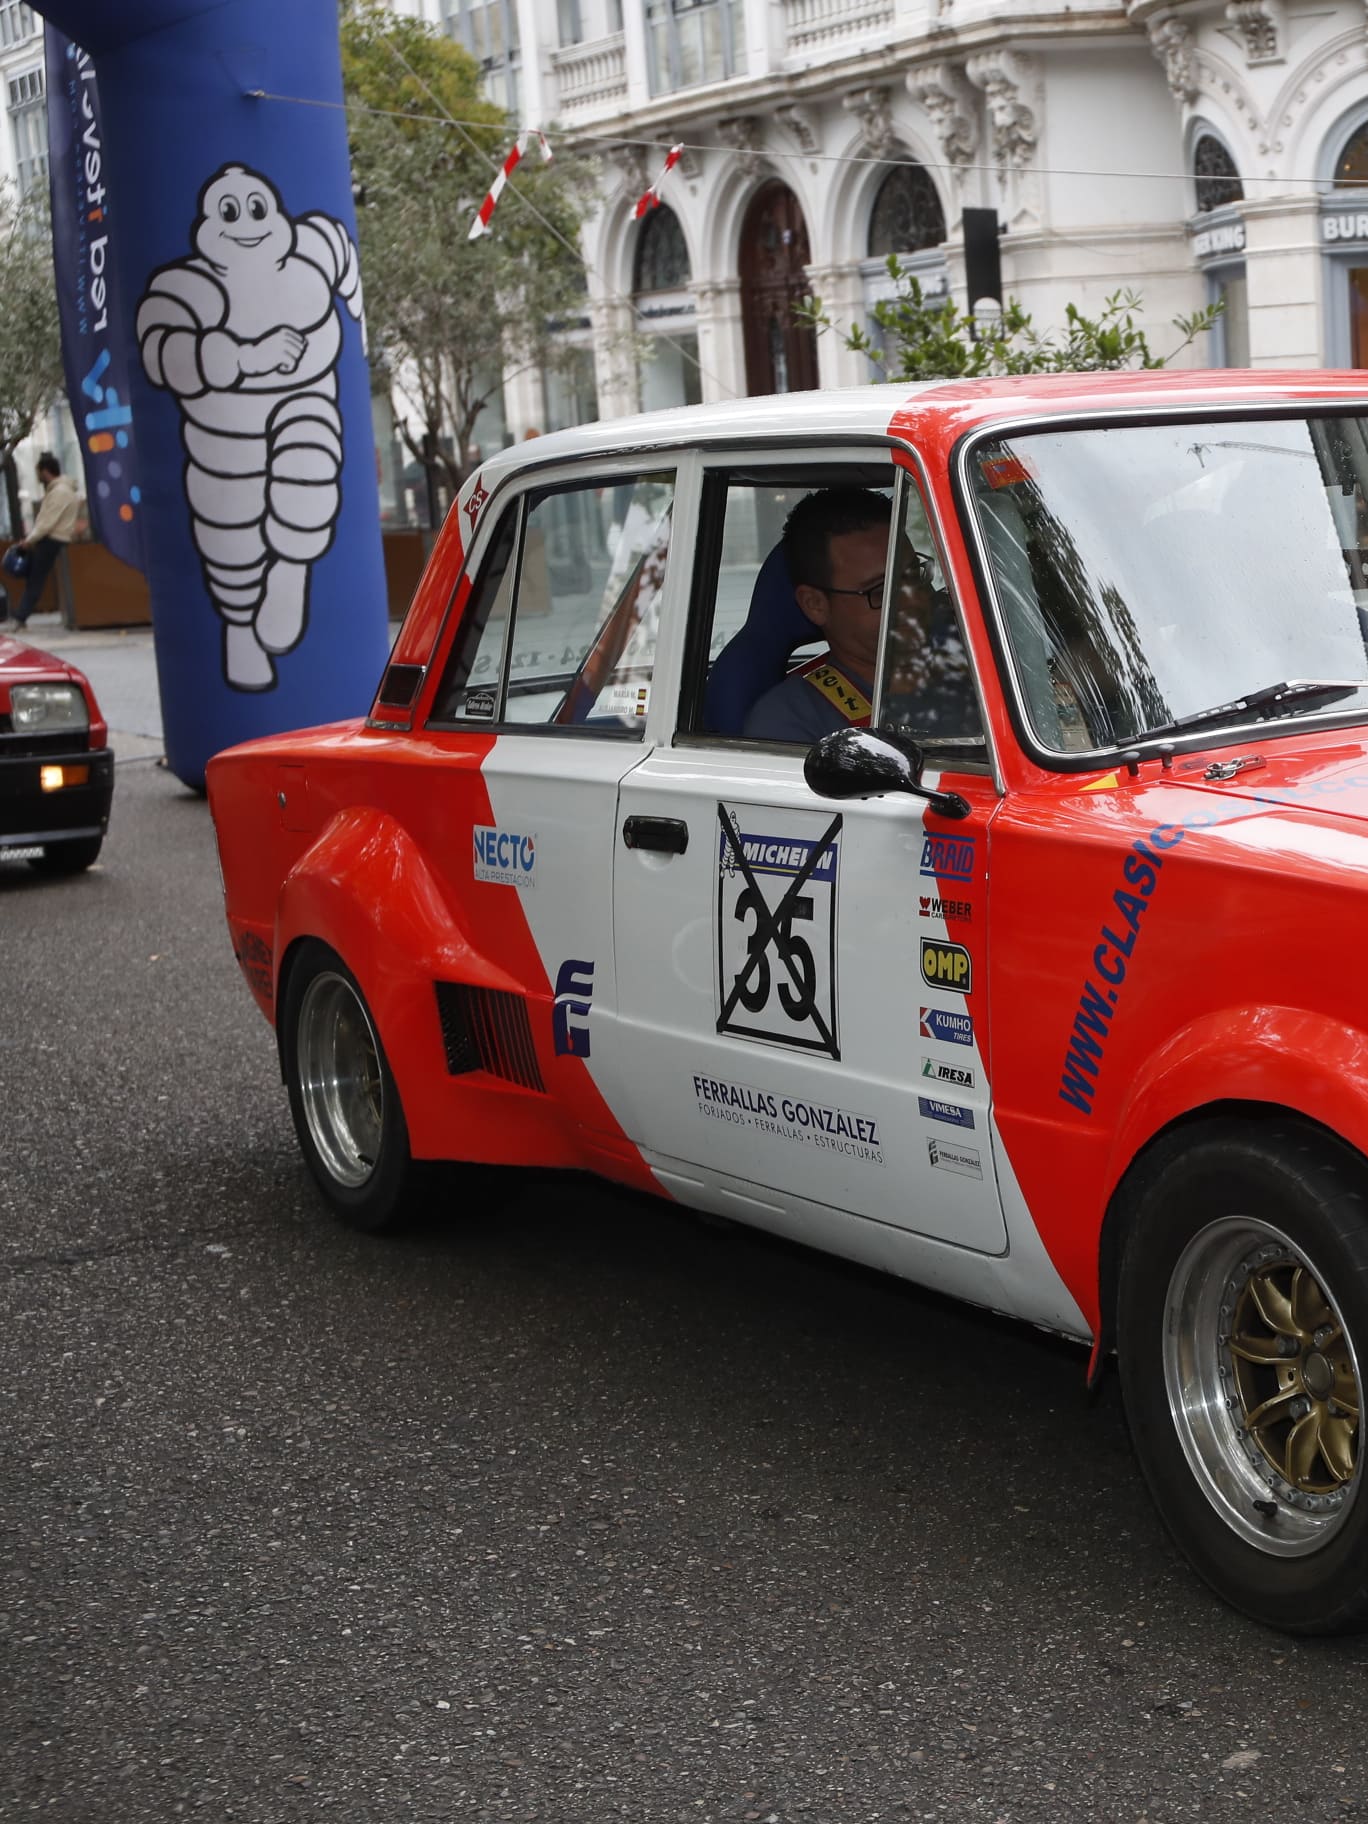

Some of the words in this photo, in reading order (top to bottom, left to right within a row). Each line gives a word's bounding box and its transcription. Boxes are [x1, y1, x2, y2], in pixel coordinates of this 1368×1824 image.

[474, 831, 535, 872] NECTO
[742, 841, 833, 870] MICHELN
[920, 840, 975, 873] BRAID
[931, 897, 972, 917] WEBER
[734, 887, 817, 1022] 35
[924, 948, 968, 982] OMP
[936, 1013, 972, 1032] KUMHO
[952, 1032, 973, 1044] TIRES
[938, 1065, 973, 1085] IRESA
[692, 1075, 778, 1119] FERRALLAS
[781, 1099, 881, 1146] GONZÁLEZ
[929, 1100, 963, 1118] VIMESA
[698, 1102, 746, 1126] FORJADOS
[754, 1118, 805, 1142] FERRALLAS
[814, 1133, 884, 1165] ESTRUCTURAS
